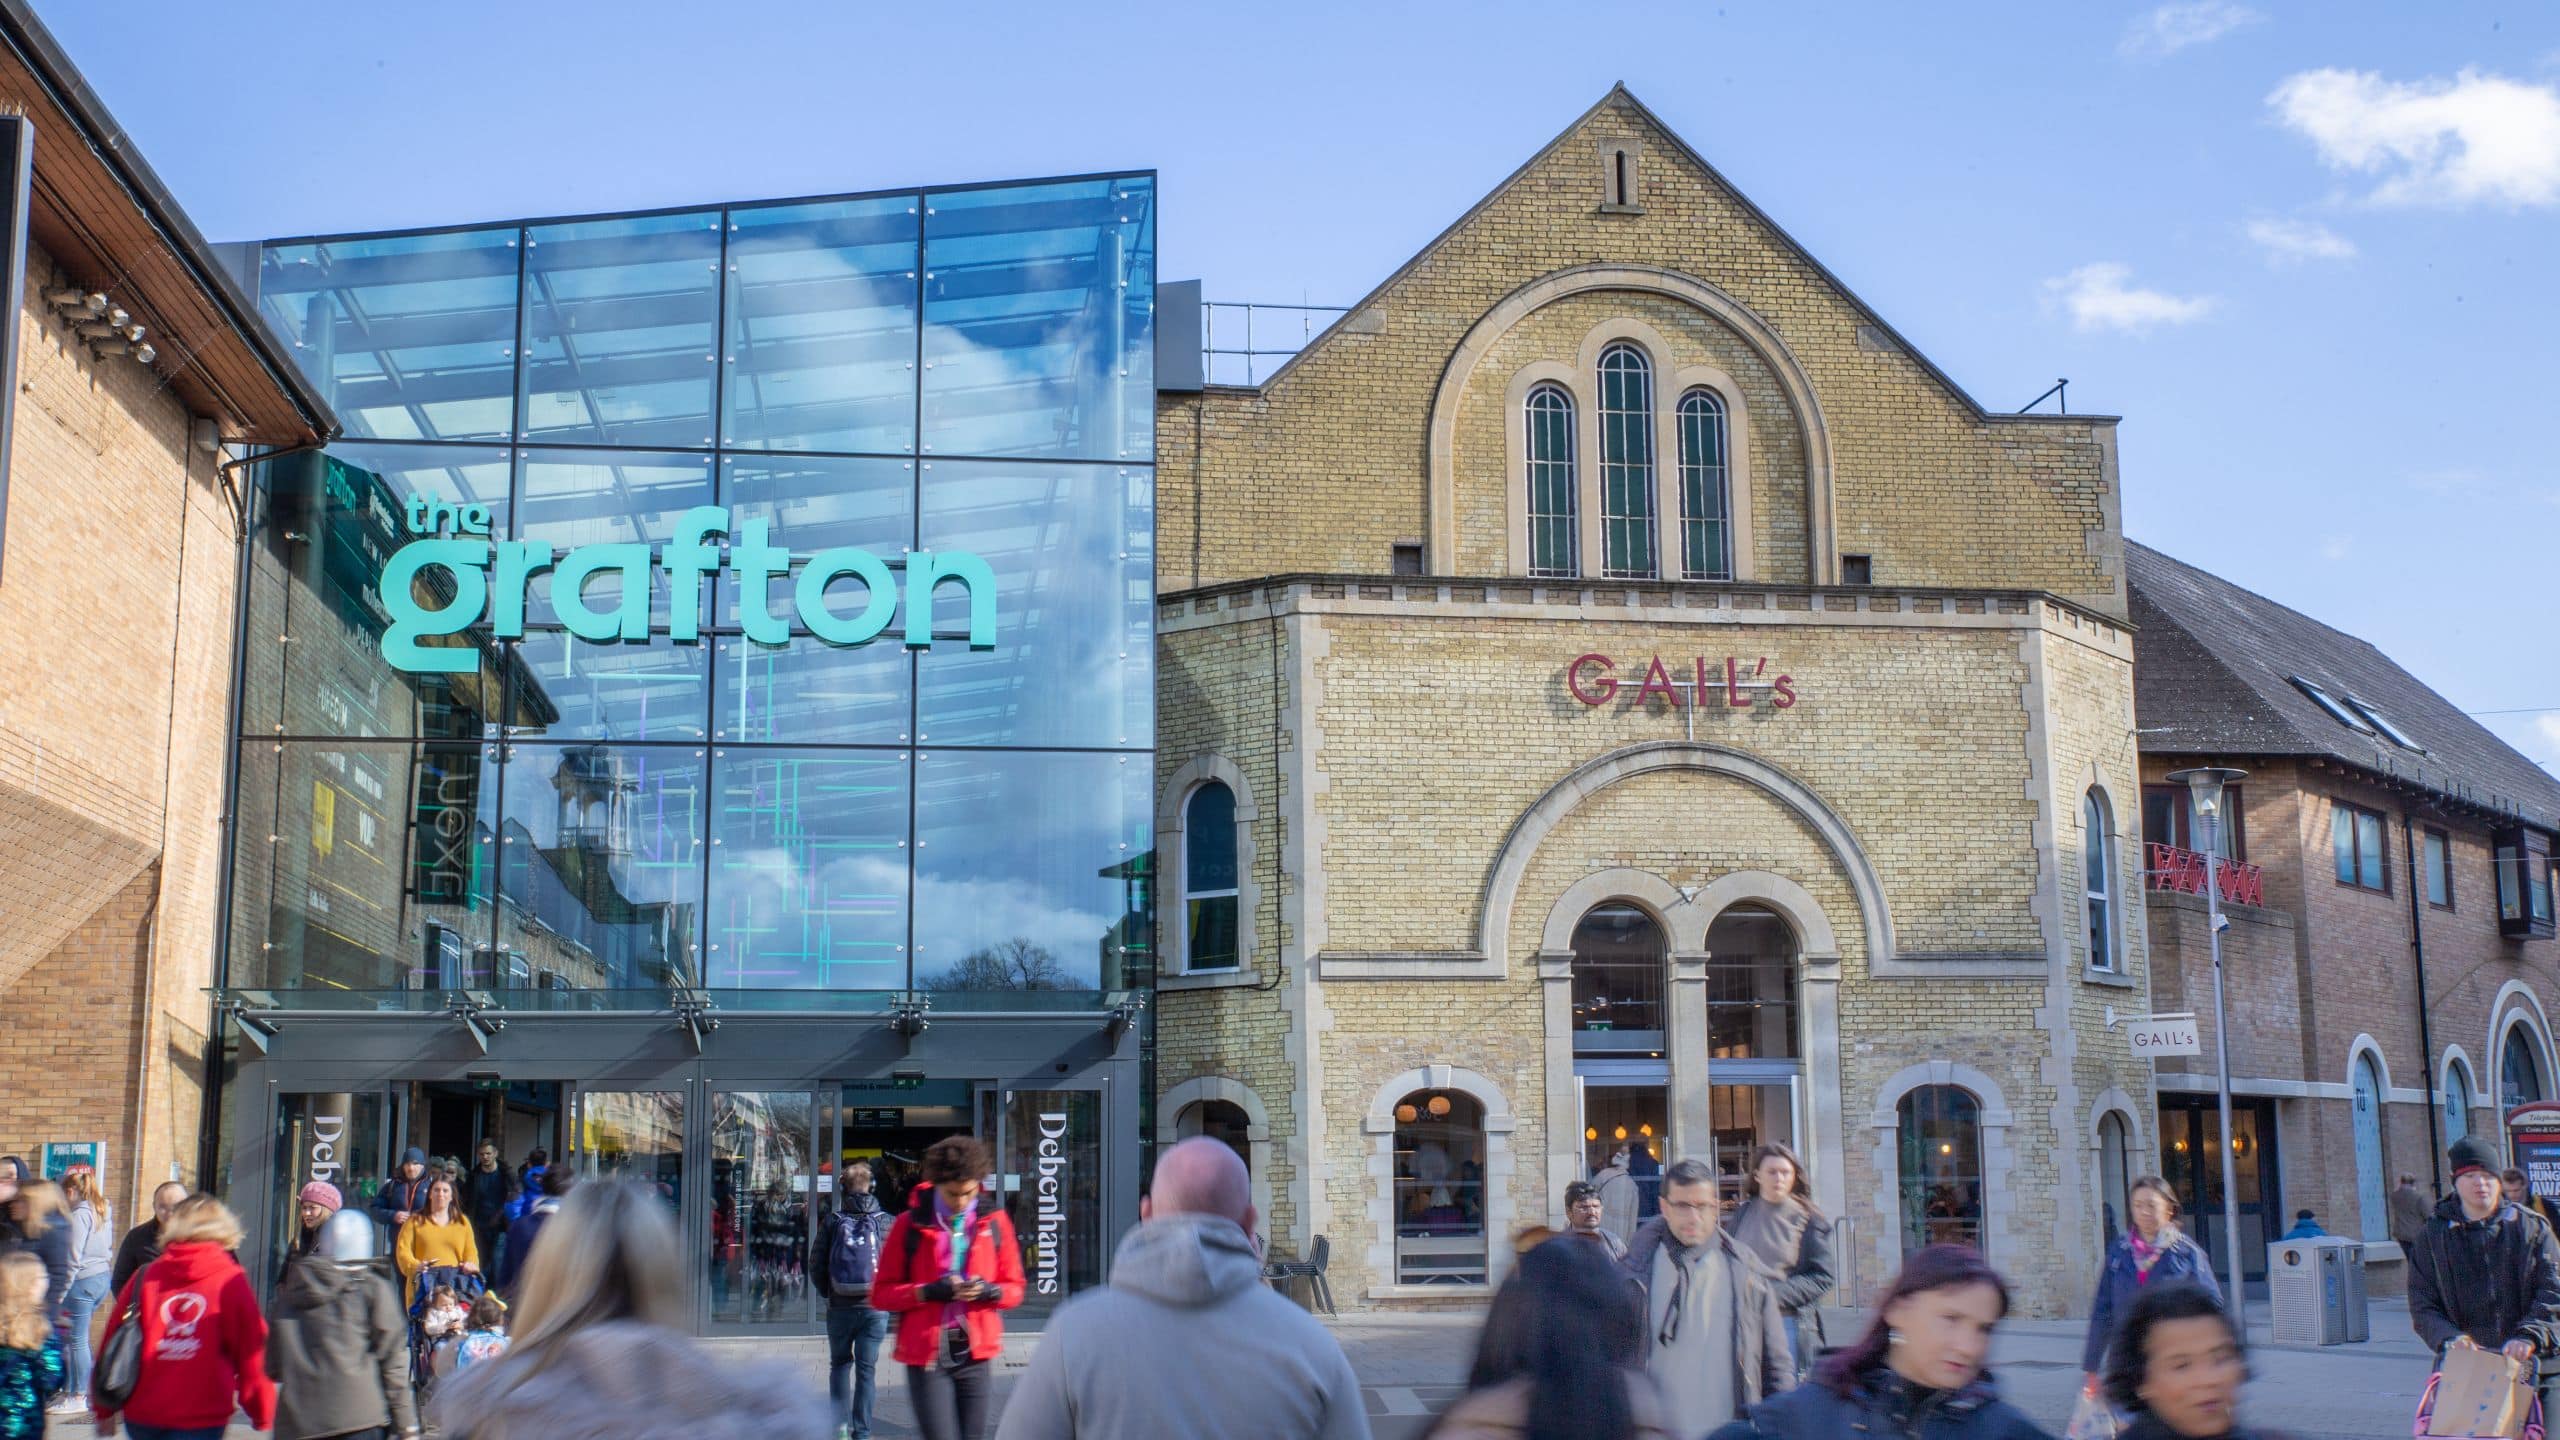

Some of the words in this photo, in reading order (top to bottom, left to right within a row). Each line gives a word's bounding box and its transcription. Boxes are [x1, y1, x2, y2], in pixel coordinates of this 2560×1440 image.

[406, 491, 490, 534] the
[380, 506, 997, 672] grafton
[1568, 653, 1796, 708] GAIL's
[2134, 1031, 2194, 1047] GAIL's
[1037, 1113, 1067, 1294] Debenhams
